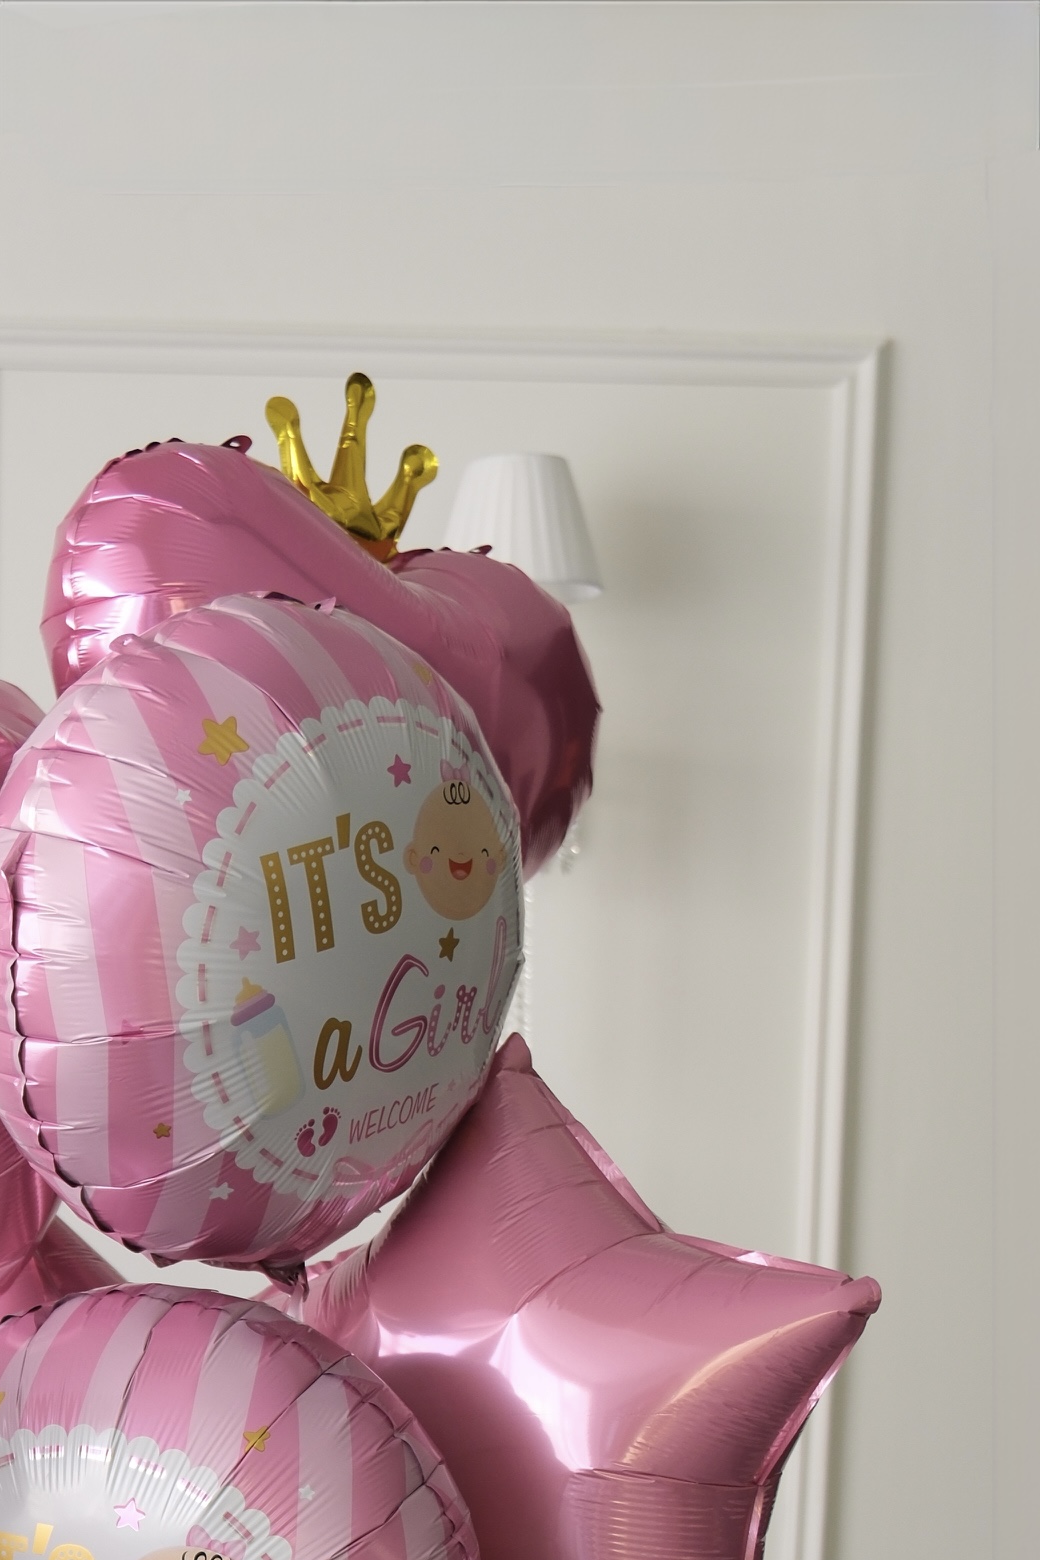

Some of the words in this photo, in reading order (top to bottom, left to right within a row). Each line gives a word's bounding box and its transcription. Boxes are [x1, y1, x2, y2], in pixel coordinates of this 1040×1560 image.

[259, 813, 402, 964] IT'S
[313, 1017, 363, 1091] a
[368, 915, 507, 1073] Girl
[348, 1082, 439, 1146] WELCOME
